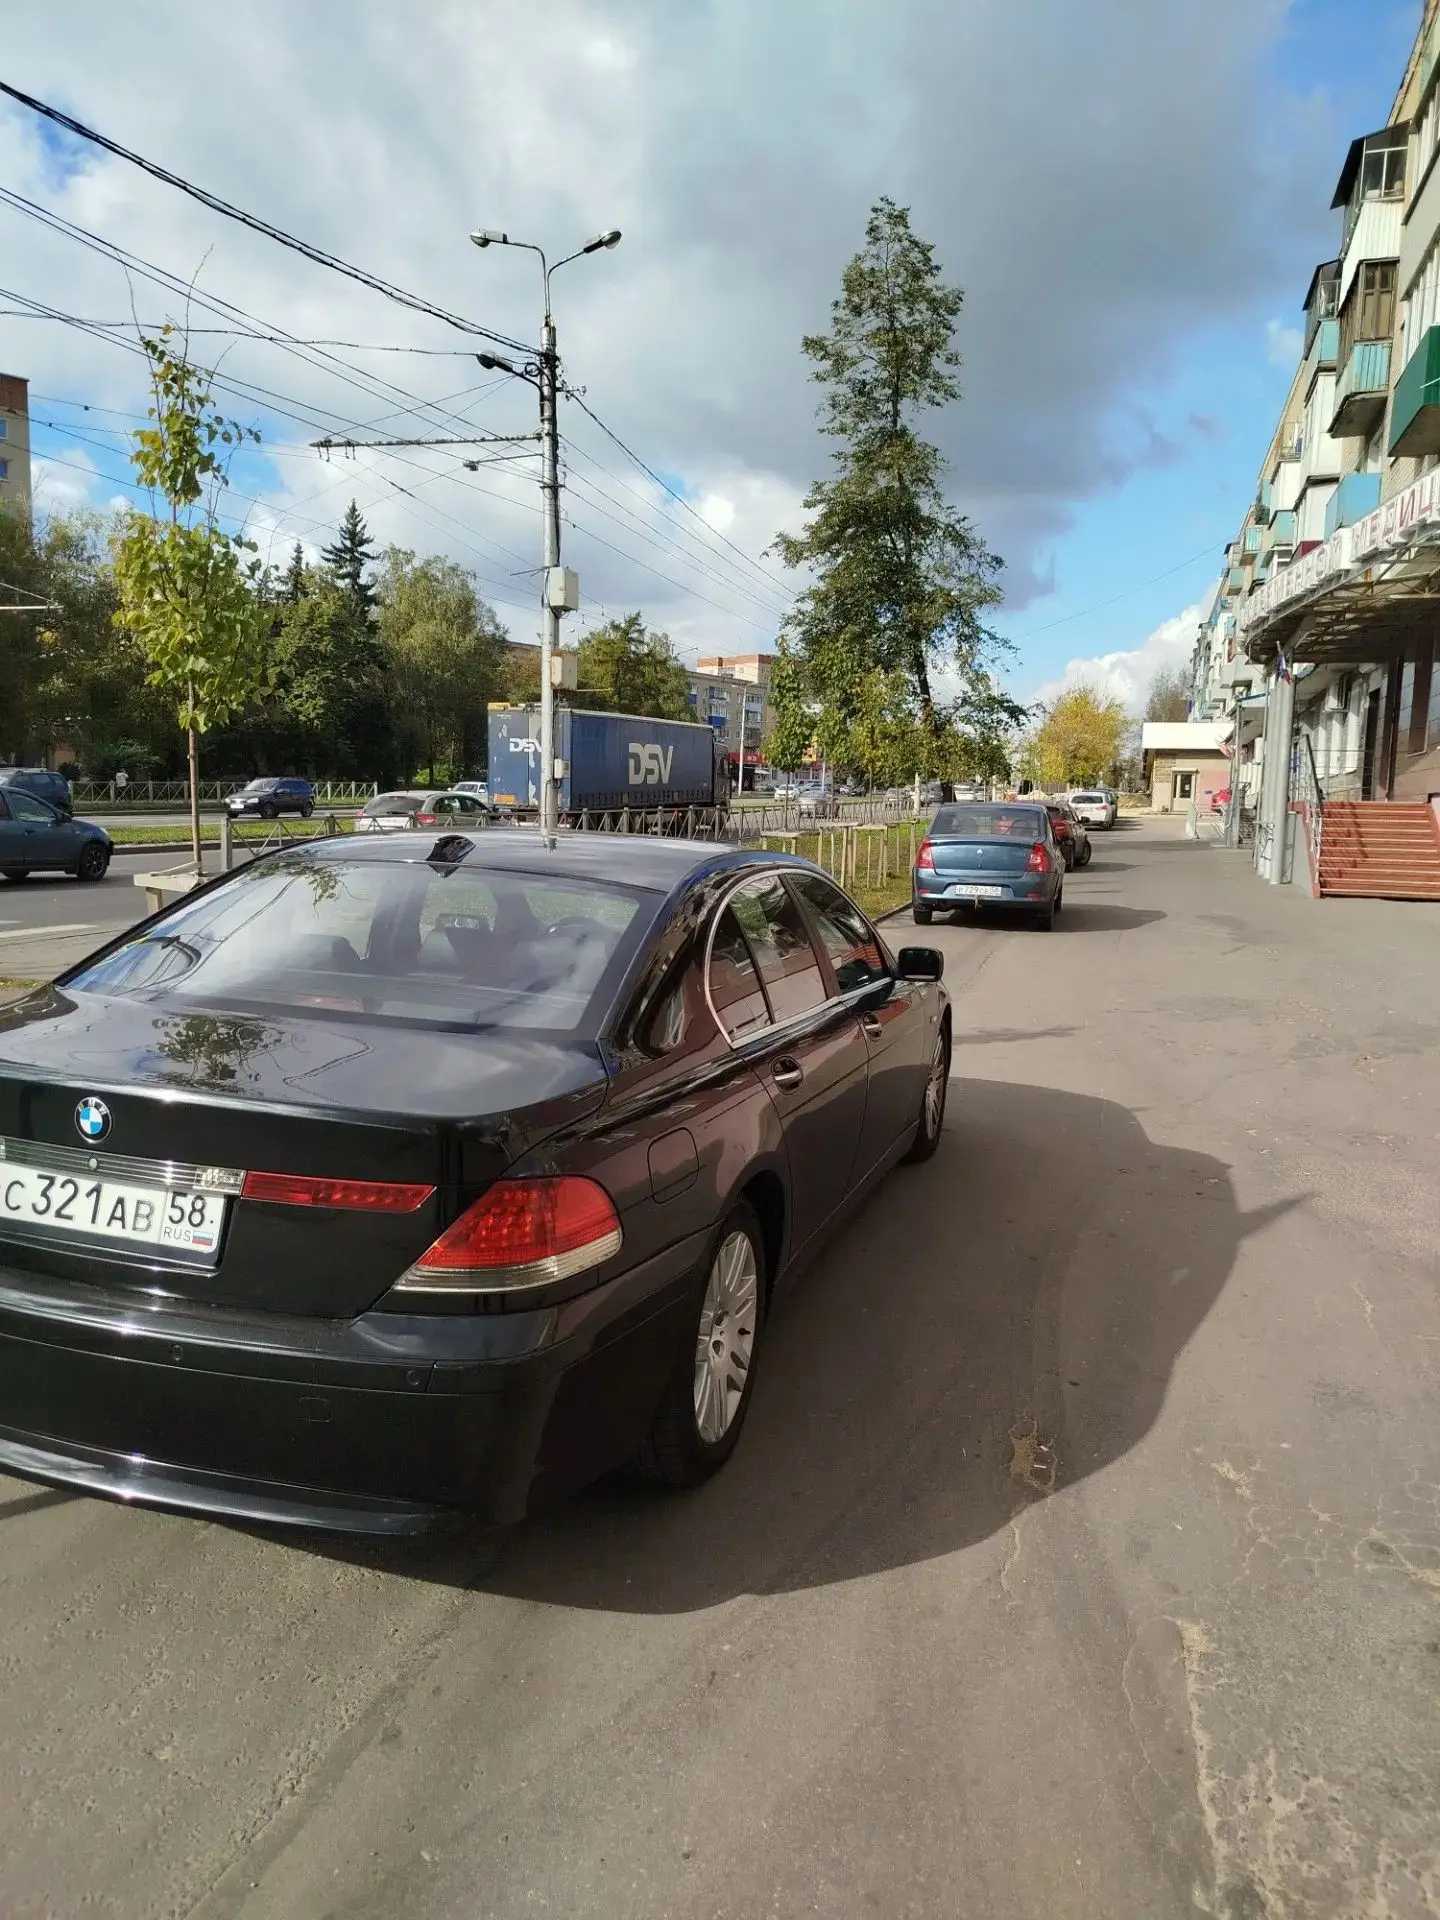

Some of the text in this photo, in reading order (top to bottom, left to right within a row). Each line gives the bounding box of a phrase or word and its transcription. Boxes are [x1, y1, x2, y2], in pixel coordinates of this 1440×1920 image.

[1352, 473, 1440, 553] МЕДИЦ
[628, 743, 674, 785] DSV
[163, 1226, 191, 1241] RUS
